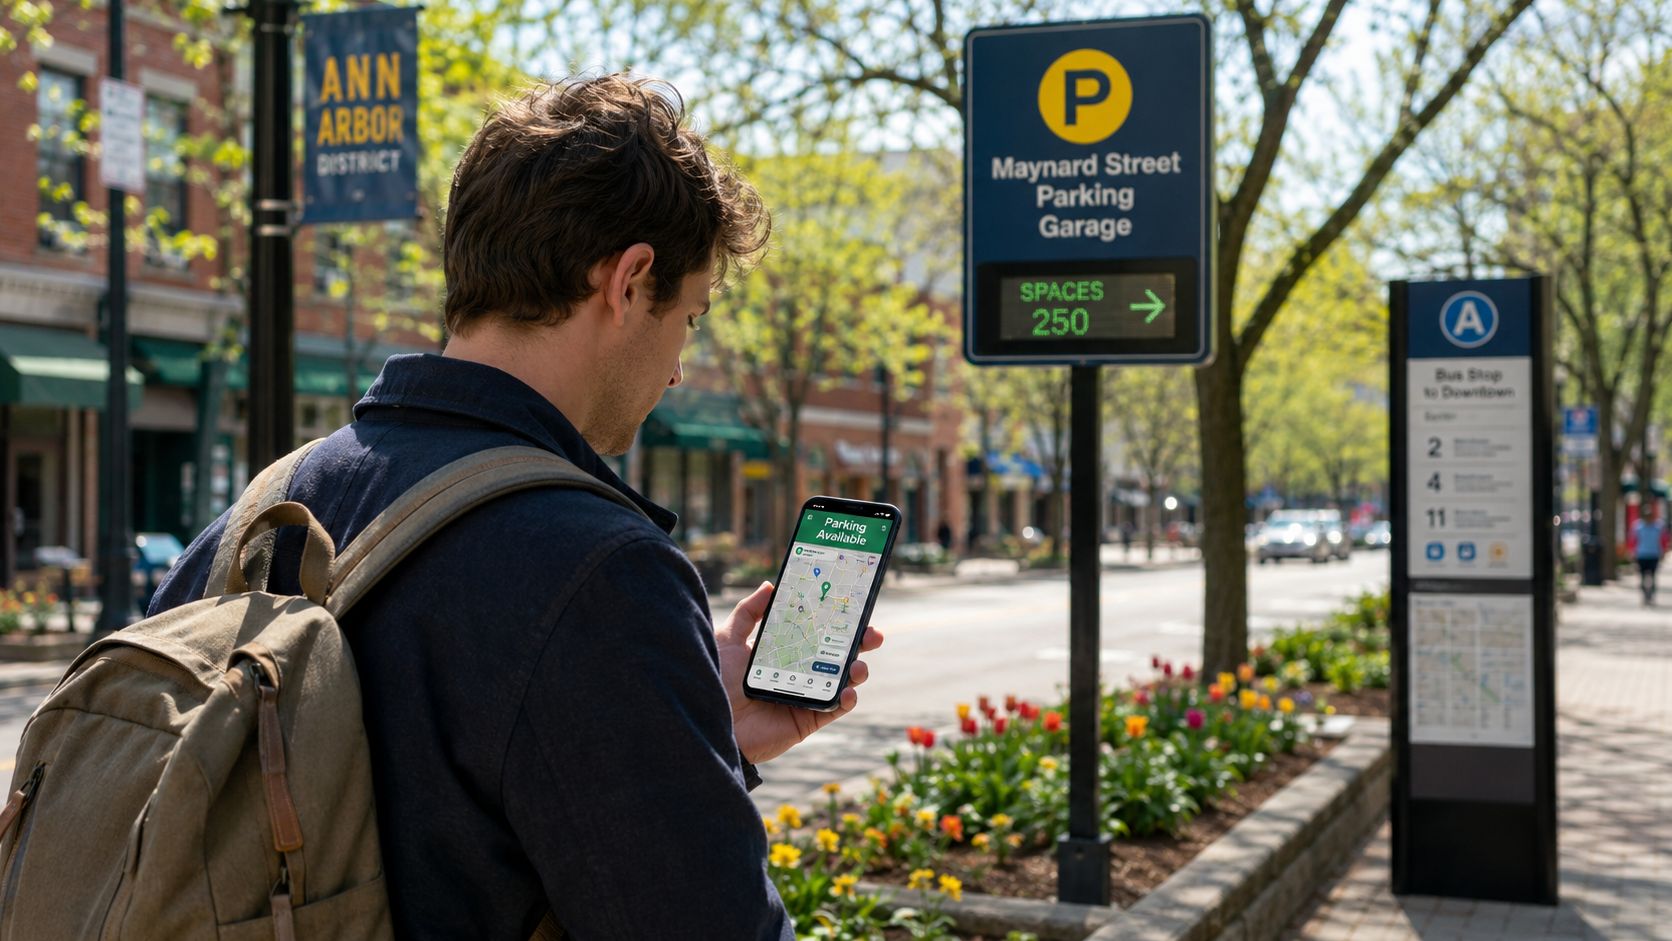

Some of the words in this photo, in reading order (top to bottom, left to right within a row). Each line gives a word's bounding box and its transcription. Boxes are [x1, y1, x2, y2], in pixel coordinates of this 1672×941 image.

[320, 53, 400, 103] ANN
[1064, 68, 1111, 127] P
[317, 104, 404, 145] ARBOR
[317, 150, 401, 176] DISTRICT
[992, 153, 1098, 183] Maynard
[1105, 151, 1181, 175] Street
[1036, 183, 1135, 211] Parking
[1039, 214, 1132, 242] Garage
[1020, 281, 1104, 302] SPACES
[1032, 308, 1089, 336] 250
[1453, 300, 1485, 336] A
[1435, 367, 1463, 382] Bus
[1467, 367, 1503, 384] Stop
[1424, 386, 1438, 399] to
[1441, 384, 1516, 400] Downtown
[1428, 436, 1442, 458] 2
[1427, 472, 1441, 493] 4
[824, 517, 867, 534] Parking
[1427, 507, 1446, 528] 11
[816, 529, 867, 546] Available
